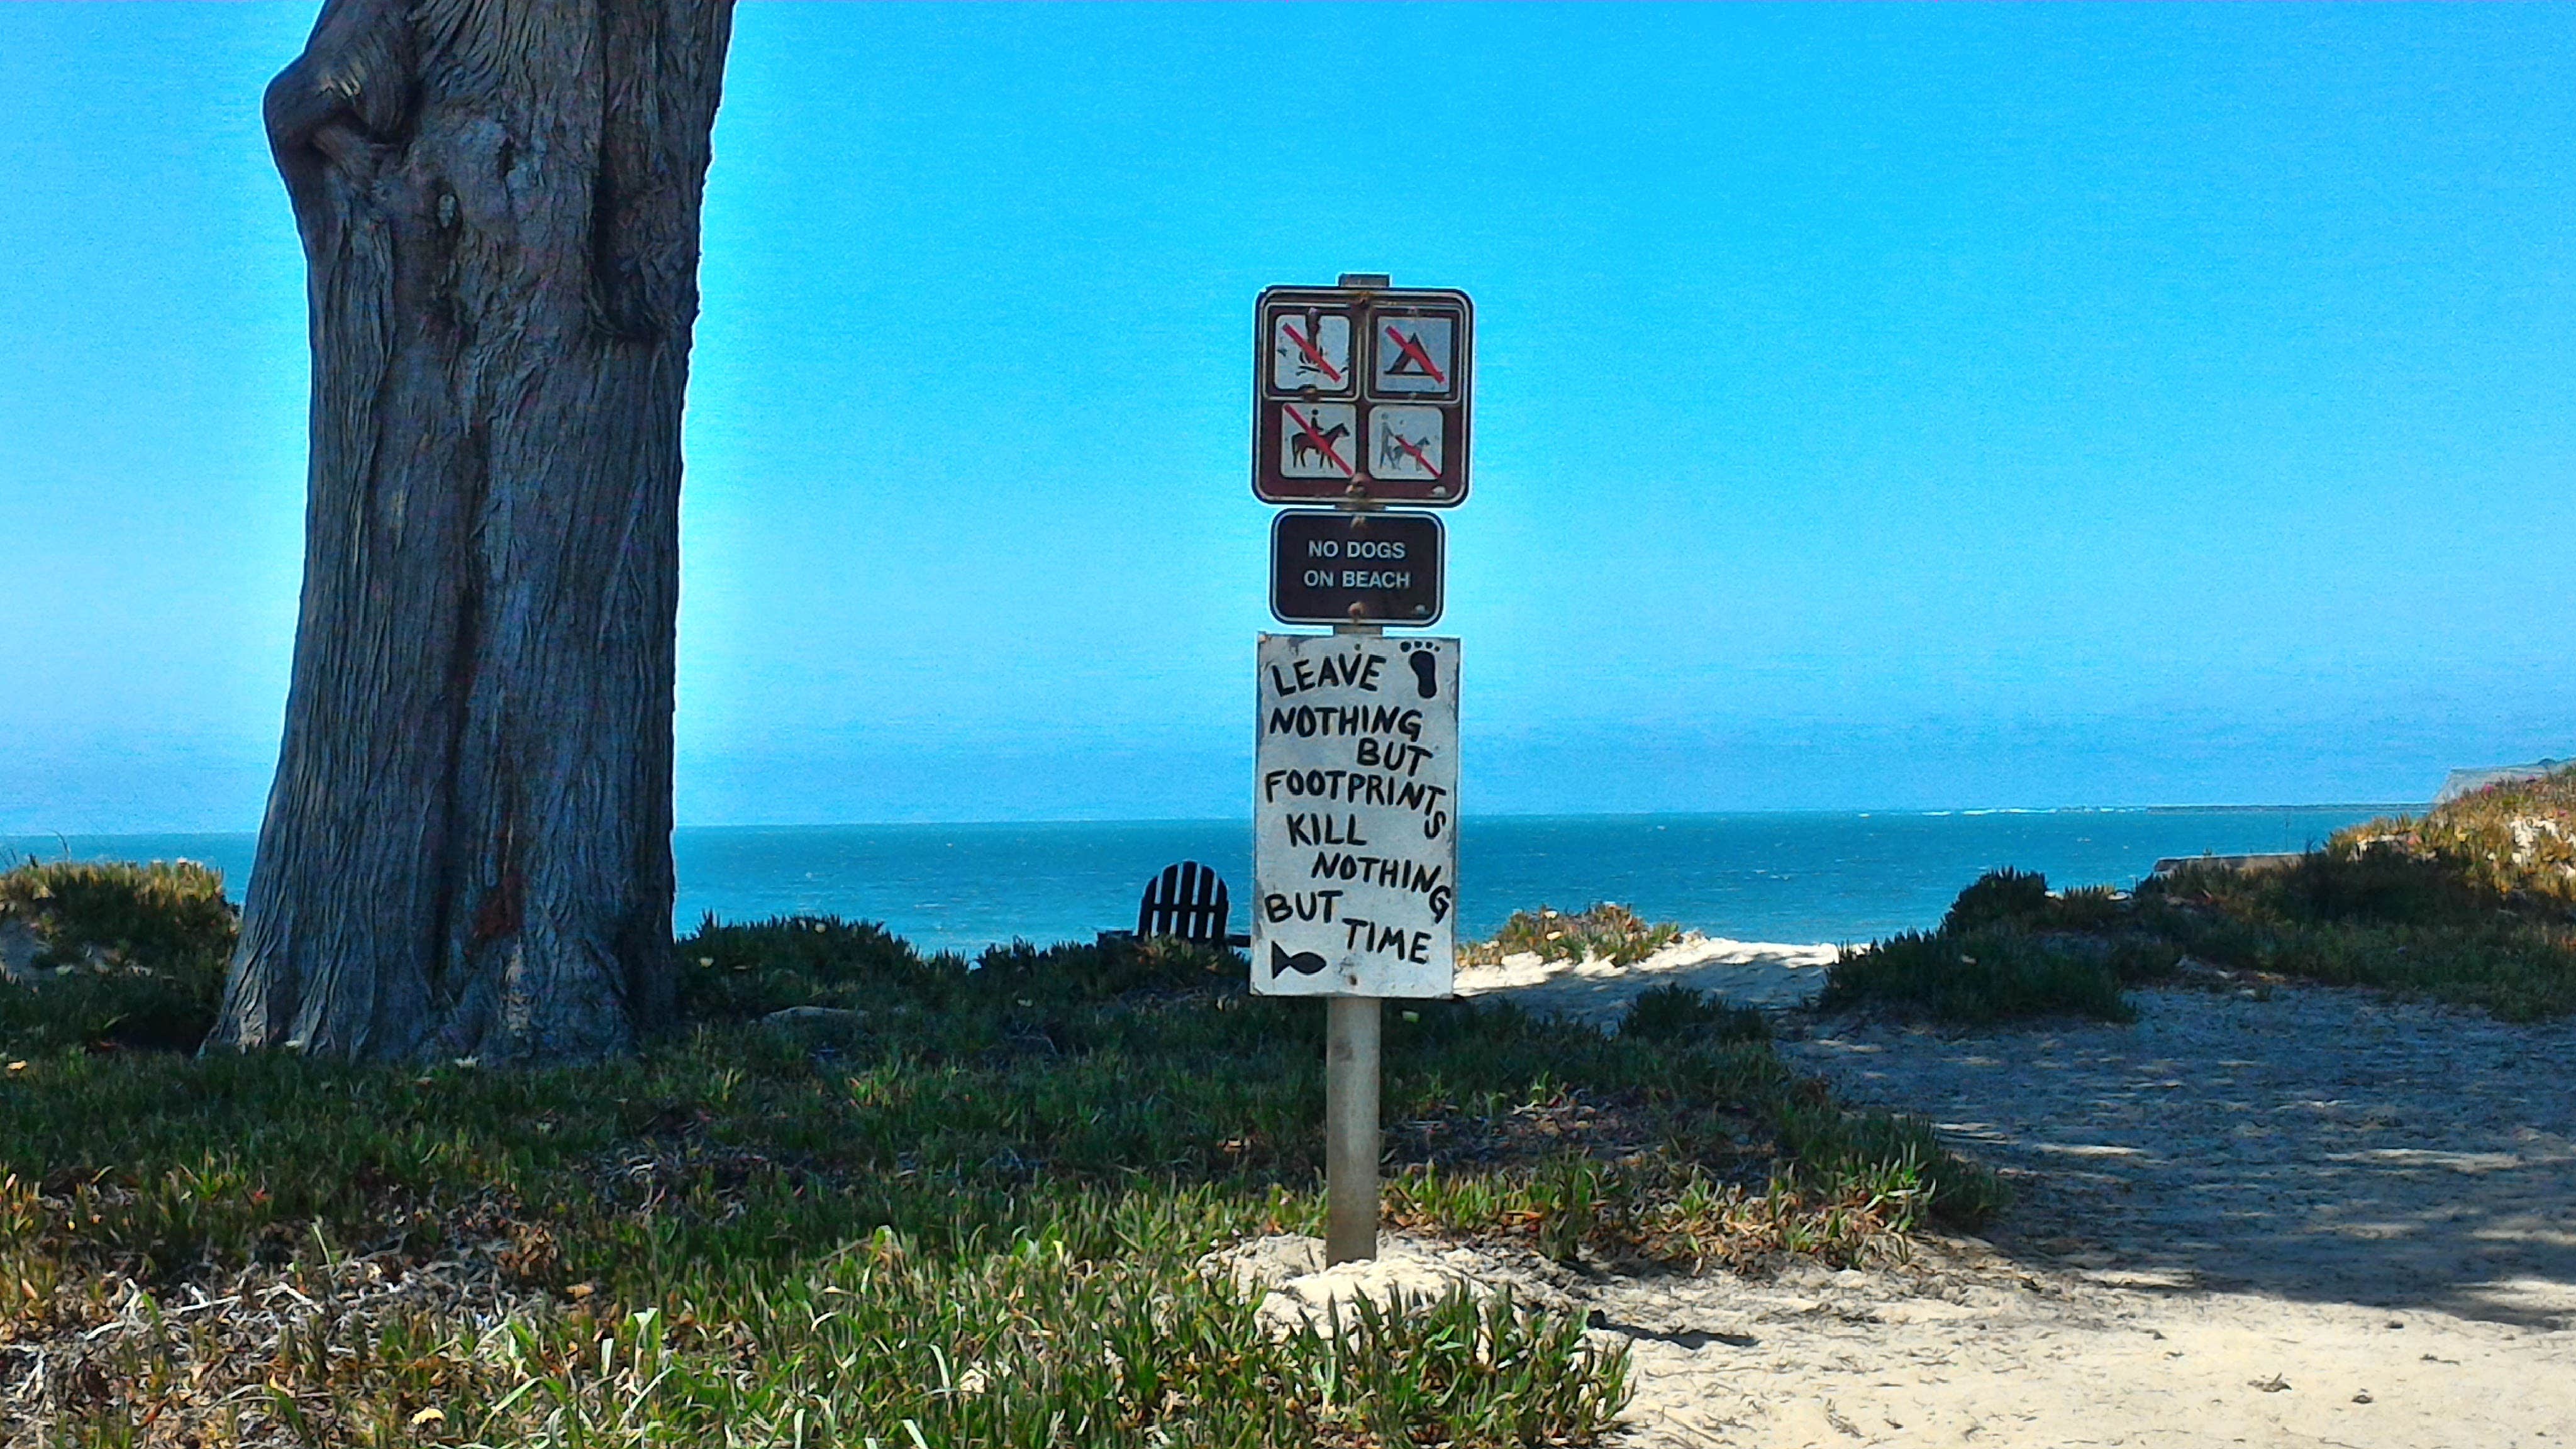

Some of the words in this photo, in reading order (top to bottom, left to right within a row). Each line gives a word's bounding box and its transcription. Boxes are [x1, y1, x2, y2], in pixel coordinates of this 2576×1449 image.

[1308, 540, 1338, 558] NO
[1347, 541, 1406, 559] DOGS
[1304, 570, 1333, 587] ON
[1342, 570, 1411, 589] BEACH
[1272, 653, 1387, 697] LEAVE
[1270, 705, 1423, 742] NOTHING
[1357, 738, 1434, 777] BUT
[1265, 770, 1446, 840] FOOTPRINTS
[1287, 813, 1367, 847] KILL
[1264, 890, 1343, 923] BUT
[1311, 852, 1451, 924] NOTHING
[1342, 918, 1432, 964] TIME
